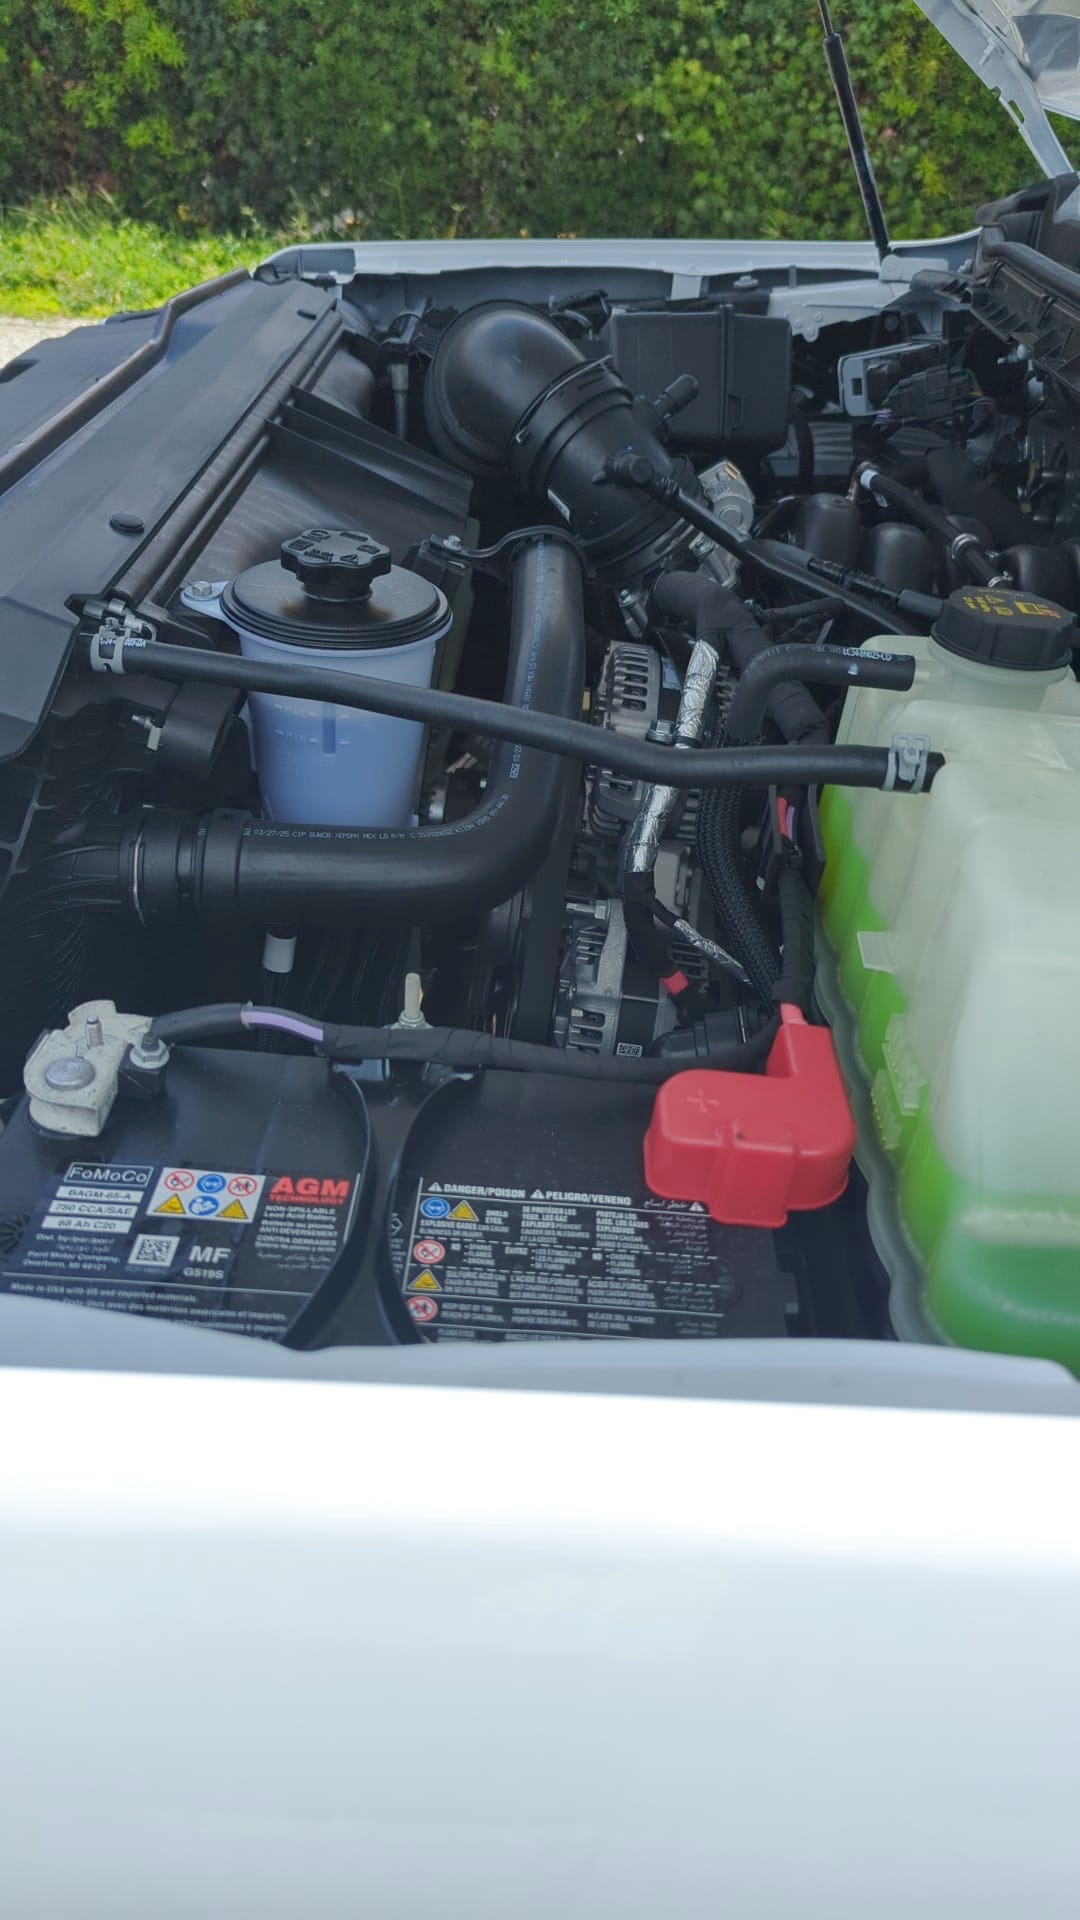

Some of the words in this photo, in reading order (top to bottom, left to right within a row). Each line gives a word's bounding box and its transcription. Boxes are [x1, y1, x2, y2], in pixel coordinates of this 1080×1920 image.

[69, 1166, 148, 1184] FoMoCo
[270, 1175, 350, 1196] AGM
[68, 1190, 132, 1201] BAGM-65-A
[269, 1193, 345, 1205] TECHNOLOGY
[444, 1184, 525, 1198] DANGER/POISON
[545, 1191, 631, 1206] PELIGRO/VENENO
[55, 1203, 76, 1211] 750
[78, 1204, 133, 1216] CCA/SAE
[265, 1205, 337, 1215] NON-SPILLABLE
[74, 1219, 90, 1229] Ah
[92, 1221, 116, 1230] C20
[306, 1214, 337, 1223] Battery
[420, 1219, 455, 1229] EXPLOSIVE
[456, 1221, 477, 1230] GASES
[256, 1234, 291, 1244] CONTRA
[27, 1250, 49, 1259] Ford
[51, 1252, 76, 1260] Motor
[189, 1245, 231, 1264] MF
[182, 1266, 225, 1280] G519S
[11, 1282, 34, 1290] Made
[47, 1285, 64, 1293] USA
[66, 1285, 84, 1294] with
[86, 1287, 98, 1295] US
[100, 1288, 116, 1296] and
[118, 1288, 155, 1299] imported
